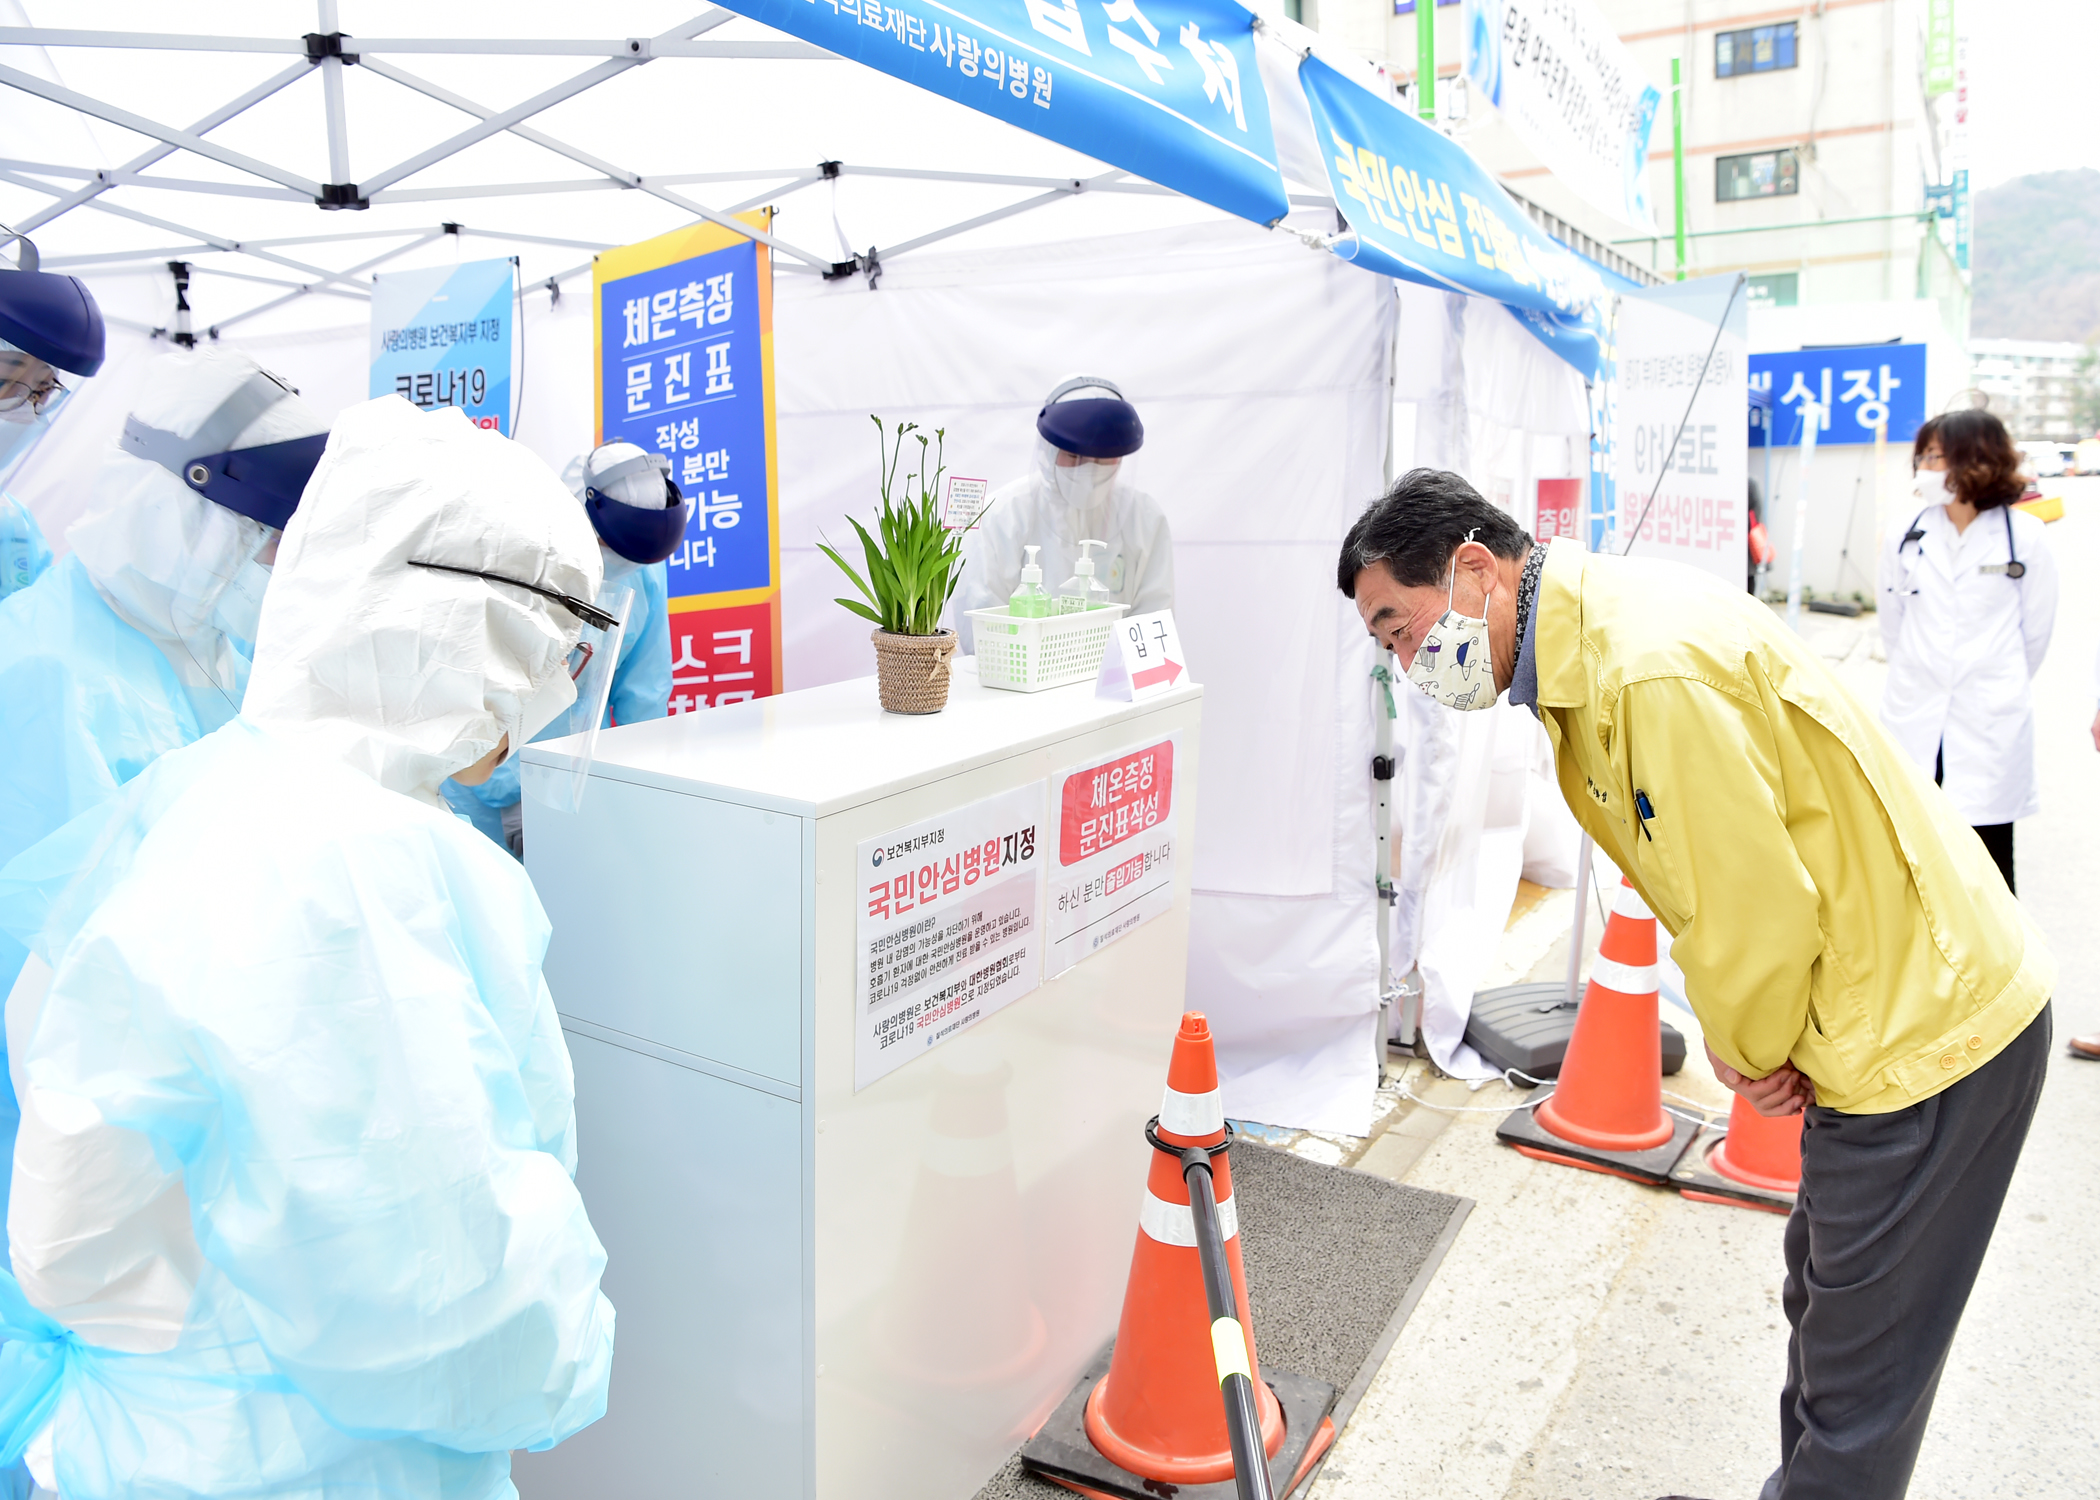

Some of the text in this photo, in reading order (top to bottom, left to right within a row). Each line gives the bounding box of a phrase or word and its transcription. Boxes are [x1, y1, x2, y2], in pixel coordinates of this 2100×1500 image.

[803, 0, 1053, 110] 의료재단 사랑의병원
[1331, 128, 1466, 259] 국민안심
[381, 318, 500, 353] 사랑의병원 보건복지부 지정
[622, 272, 734, 349] 체온측정
[656, 417, 700, 453] 작성
[682, 448, 730, 486] 분만
[669, 537, 716, 571] 니다
[671, 628, 754, 686] 스크
[1090, 754, 1154, 809] 체온측정
[886, 828, 945, 861] 보건복지부지정
[1079, 790, 1159, 857] 문진표작성
[868, 824, 1036, 921] 국민안심병원지정
[1058, 886, 1080, 913] 하신
[1083, 875, 1104, 903] 분만
[869, 981, 899, 1005] 코로나19
[900, 967, 928, 988] 걱정없이
[929, 954, 955, 976] 안전하게
[956, 948, 967, 962] 진료
[982, 938, 988, 948] 수
[990, 932, 1001, 945] 있는
[1002, 916, 1030, 938] 병원입니다.
[870, 917, 936, 955] 국민안심병원이란?
[870, 911, 983, 974] 병원 내 감염의 가능성을 차단하기 위해
[870, 907, 1021, 989] 호흡기 환자에 대한 국민안심병원을 운영하고 있습니다.
[873, 947, 1027, 1038] 사랑의병원은 보건복지부와 대한병원협회로부터
[880, 965, 1021, 1050] 코로나19 국민안심병원으로 지정되었습니다.
